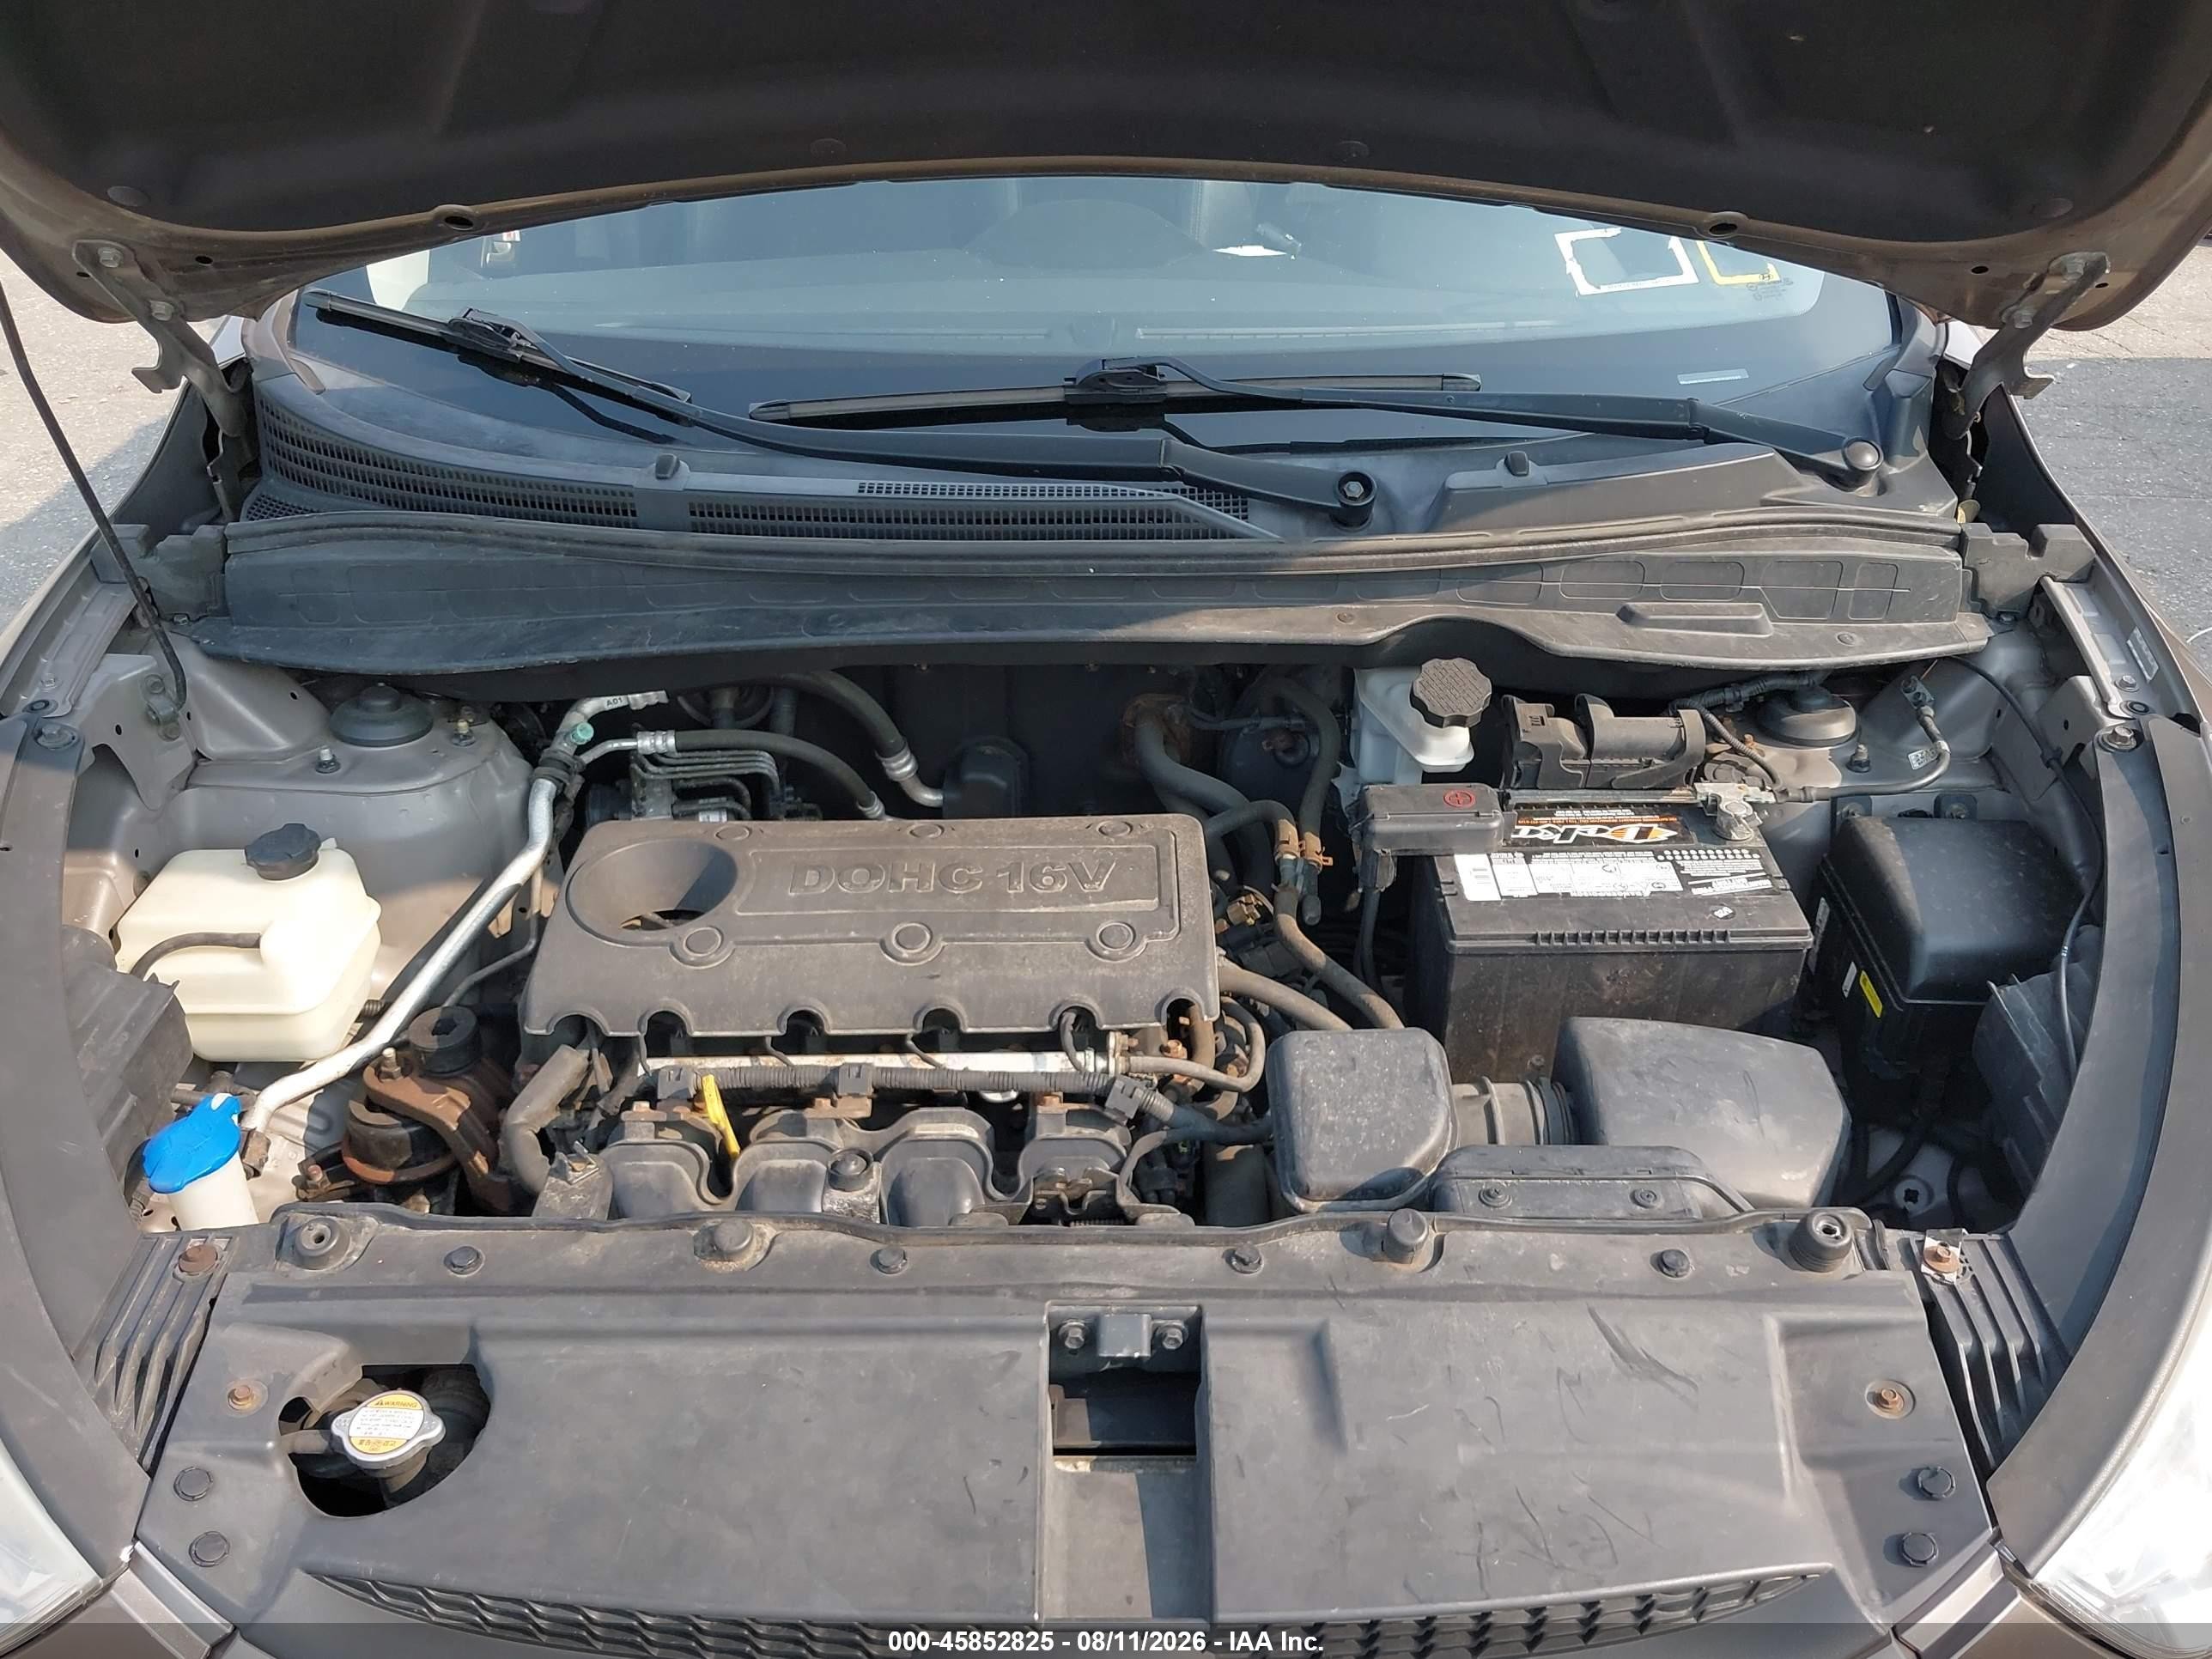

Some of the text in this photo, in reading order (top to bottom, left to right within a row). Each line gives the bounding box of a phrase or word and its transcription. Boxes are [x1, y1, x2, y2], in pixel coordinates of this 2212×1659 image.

[787, 858, 1118, 896] DOHC 16V
[384, 1400, 418, 1408] WARNING
